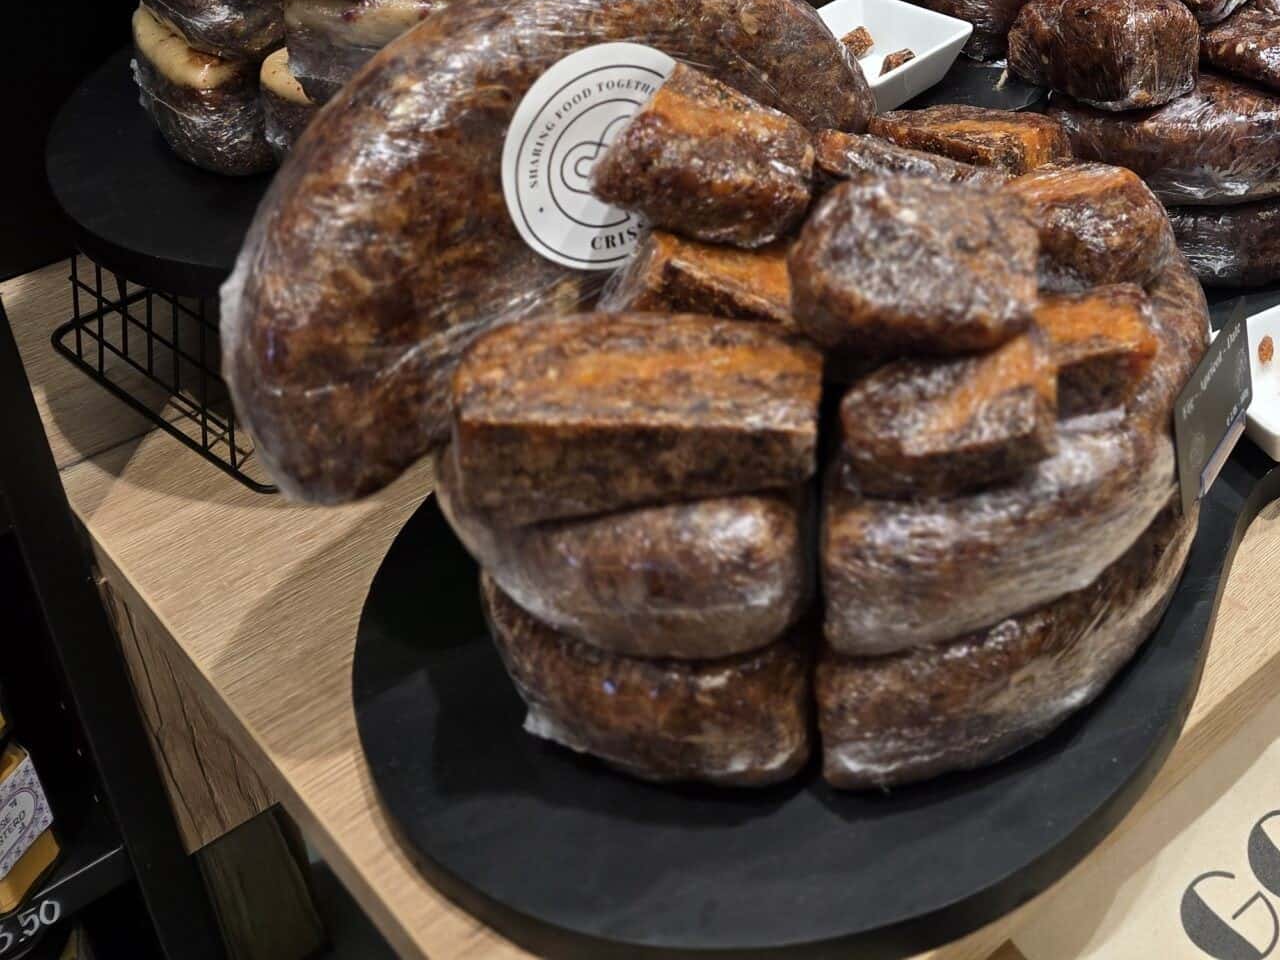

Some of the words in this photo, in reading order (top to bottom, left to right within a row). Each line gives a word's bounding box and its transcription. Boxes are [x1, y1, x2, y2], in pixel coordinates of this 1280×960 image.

[529, 120, 556, 190] SHARING
[555, 88, 592, 120] FOOD
[597, 79, 656, 96] TOGETH
